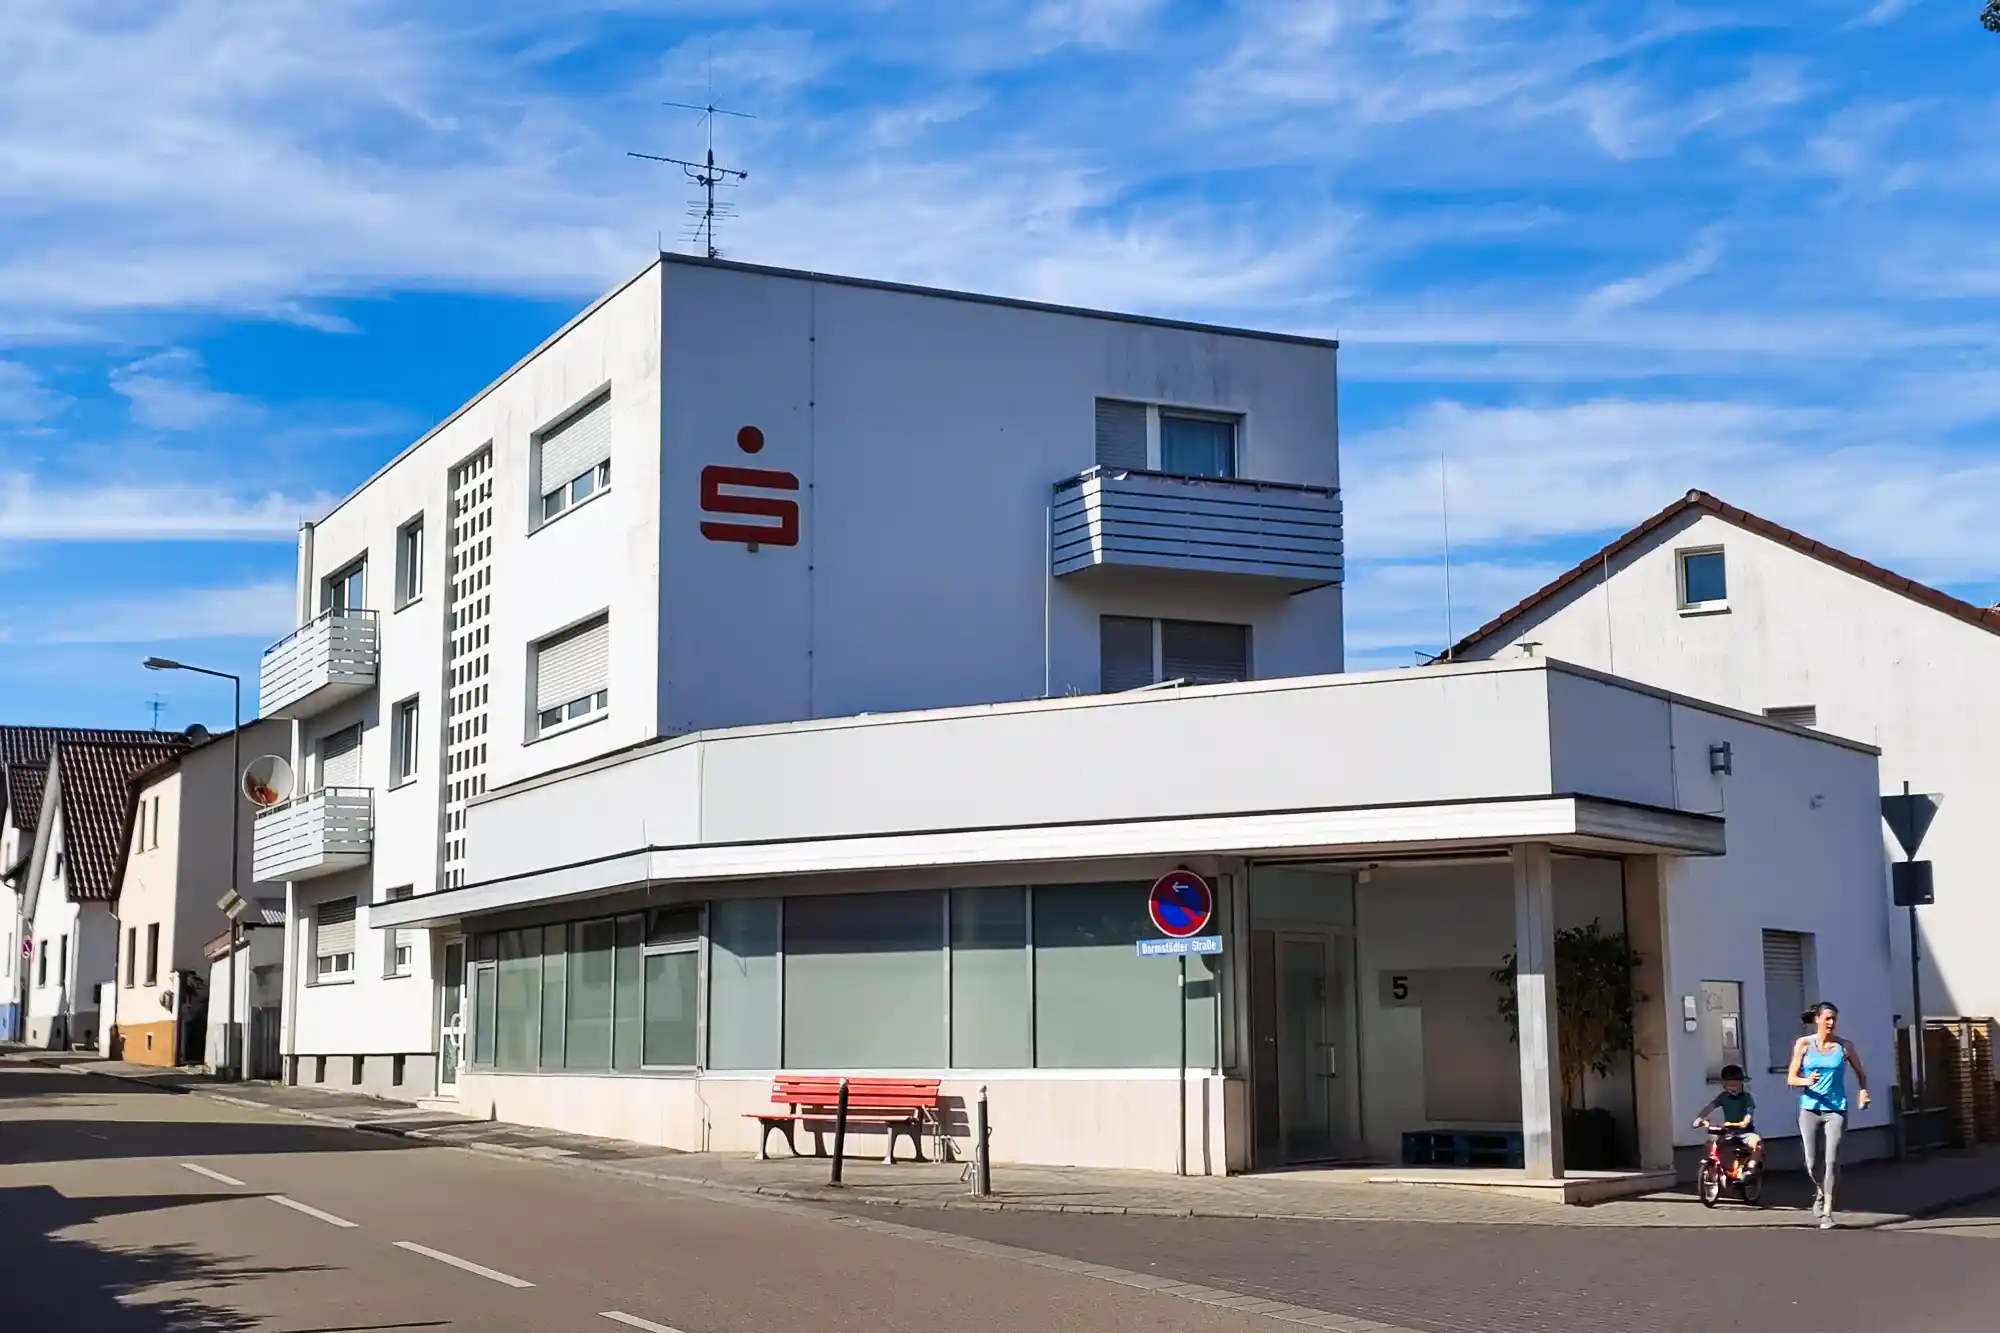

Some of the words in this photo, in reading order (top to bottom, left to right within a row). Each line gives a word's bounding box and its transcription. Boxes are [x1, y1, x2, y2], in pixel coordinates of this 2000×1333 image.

[1141, 941, 1188, 954] Darmstädter
[1192, 939, 1217, 952] Straße
[1392, 976, 1408, 1000] 5
